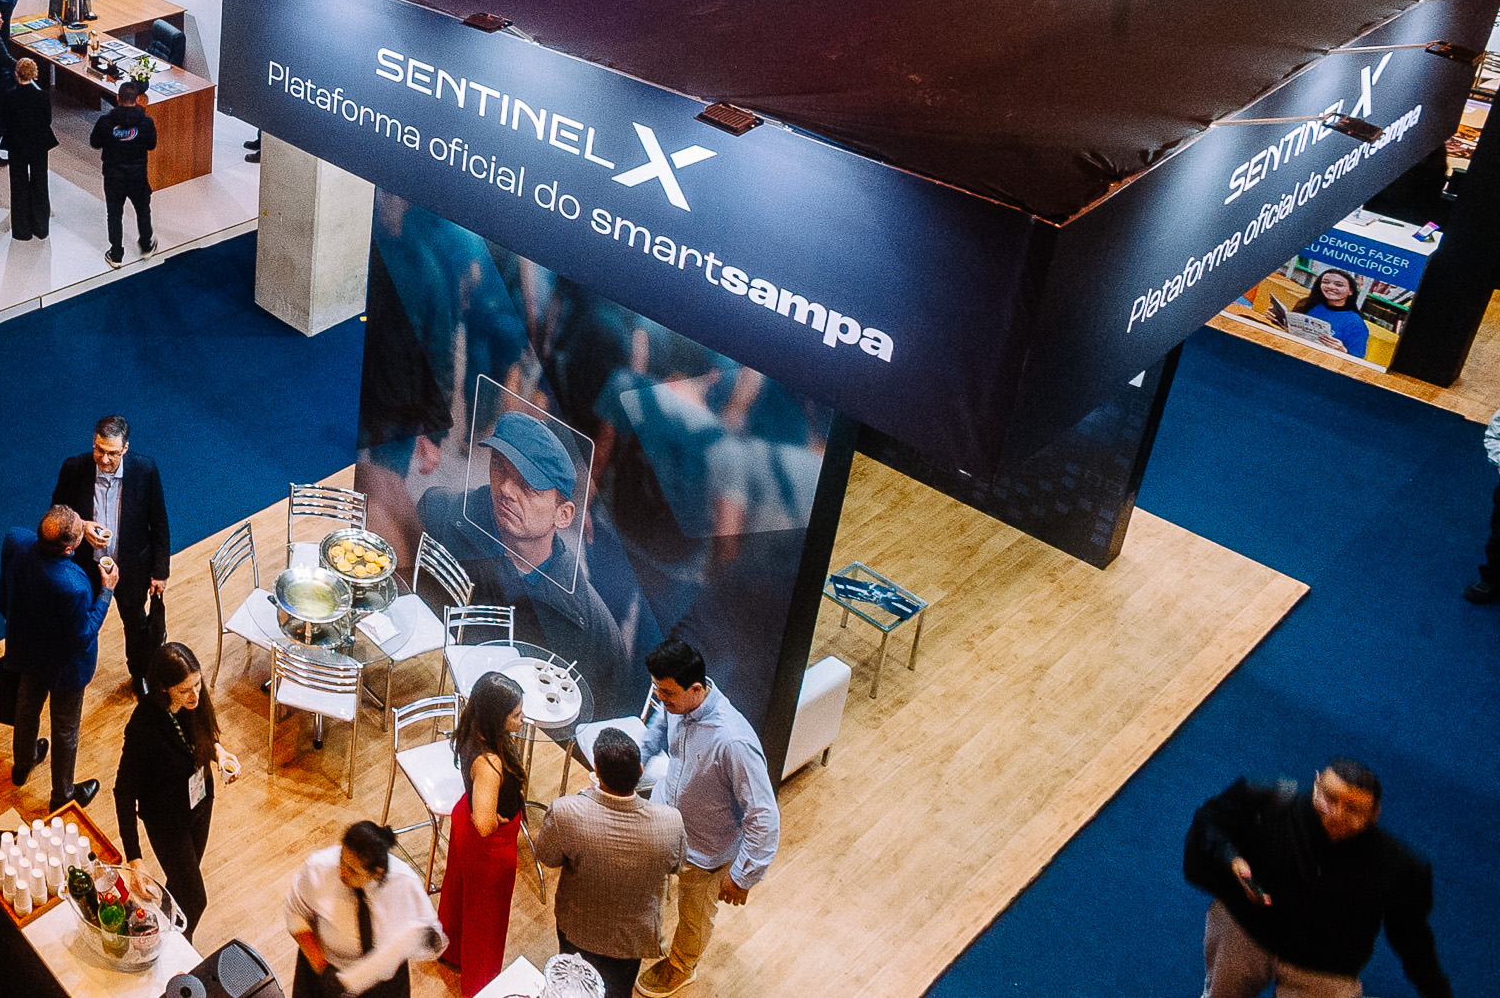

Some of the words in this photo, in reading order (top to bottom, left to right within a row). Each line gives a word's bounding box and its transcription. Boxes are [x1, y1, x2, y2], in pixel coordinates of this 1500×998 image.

[267, 61, 421, 151] Plataforma
[429, 137, 525, 197] oficial
[534, 180, 581, 220] do
[590, 207, 894, 363] smartsampa
[1126, 231, 1241, 334] Plataforma
[1243, 182, 1300, 246] oficial
[1298, 172, 1321, 206] do
[1368, 249, 1410, 269] FAZER
[1322, 247, 1399, 277] MUNICÍPIO?
